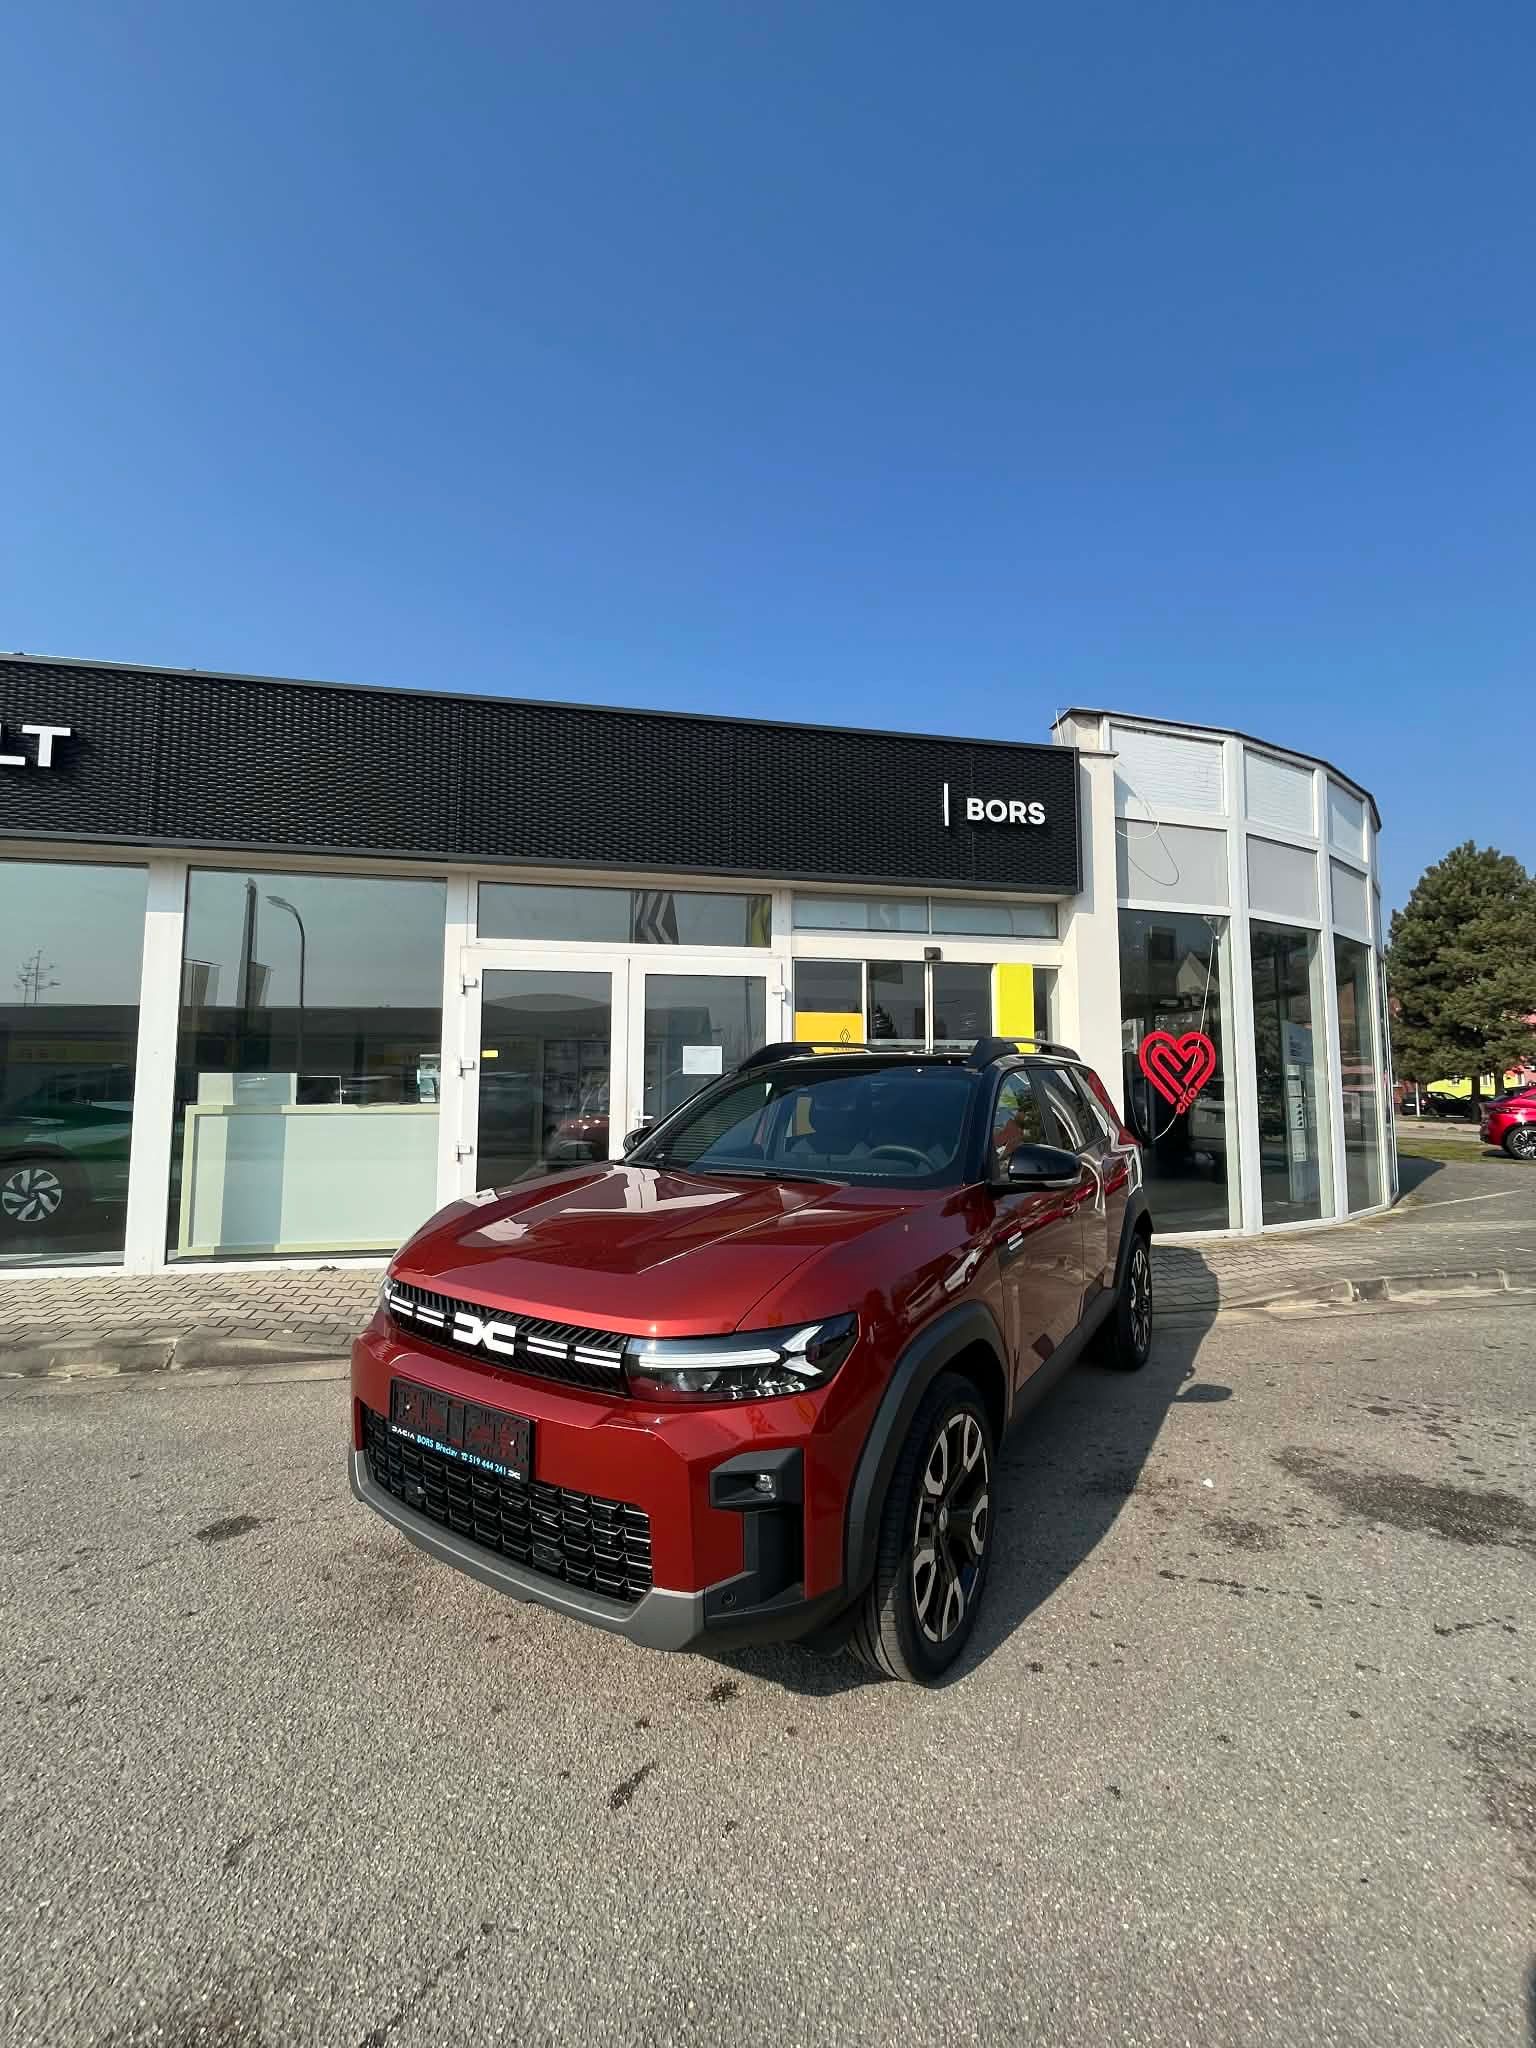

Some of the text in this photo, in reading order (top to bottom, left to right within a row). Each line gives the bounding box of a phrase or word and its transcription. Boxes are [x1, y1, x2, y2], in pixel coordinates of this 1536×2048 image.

[966, 797, 1046, 825] BORS
[391, 1425, 415, 1439] DACIA
[416, 1434, 434, 1448] BORS
[468, 1454, 481, 1466] 519
[481, 1458, 494, 1471] 444
[494, 1462, 507, 1476] 241
